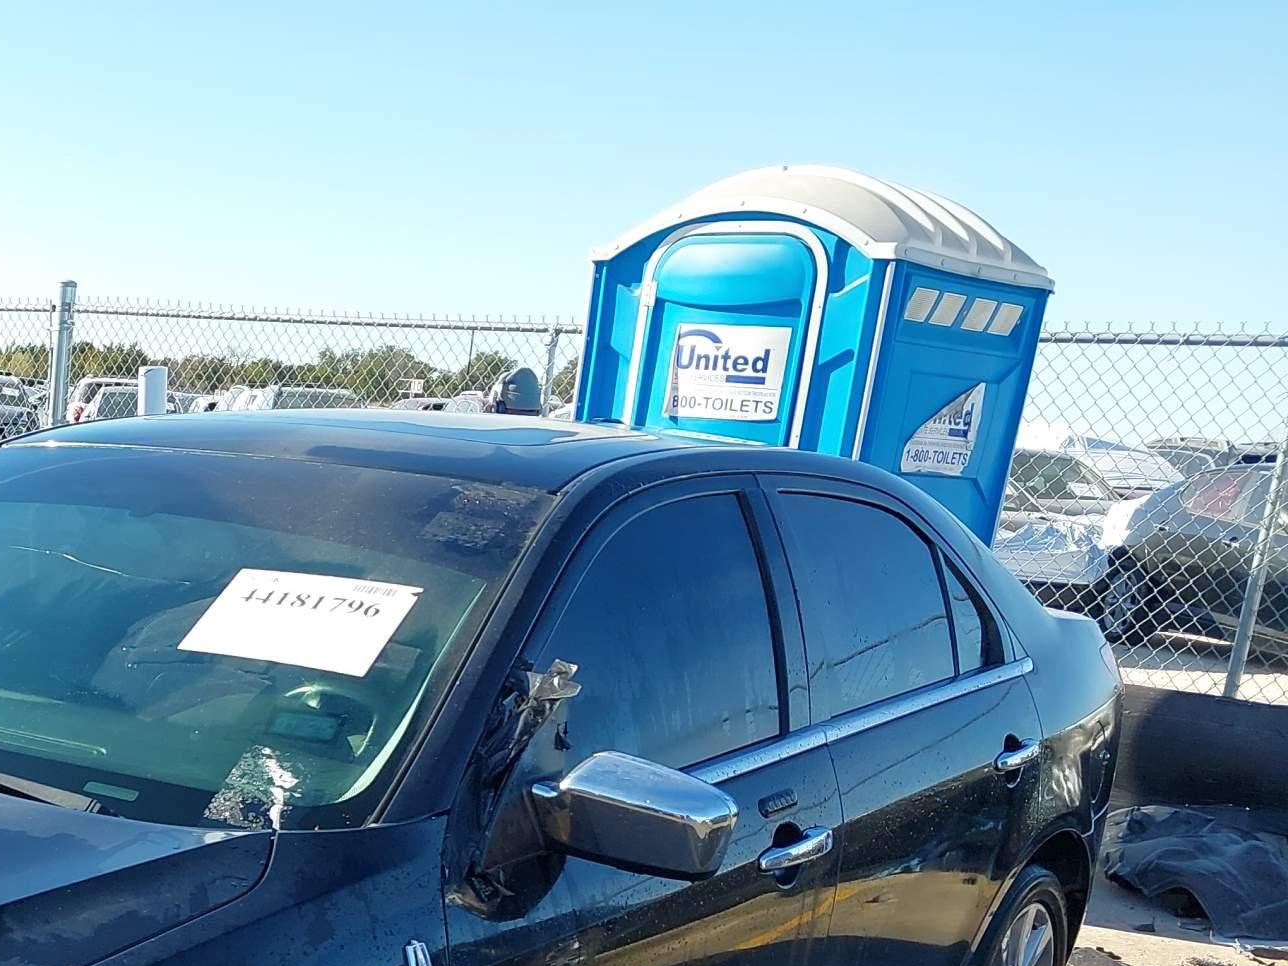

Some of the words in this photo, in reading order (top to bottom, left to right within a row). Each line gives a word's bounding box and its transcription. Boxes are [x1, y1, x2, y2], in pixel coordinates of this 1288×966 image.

[676, 345, 772, 374] United
[905, 448, 969, 466] 1-800-TOILETS
[240, 588, 381, 618] 44181796
